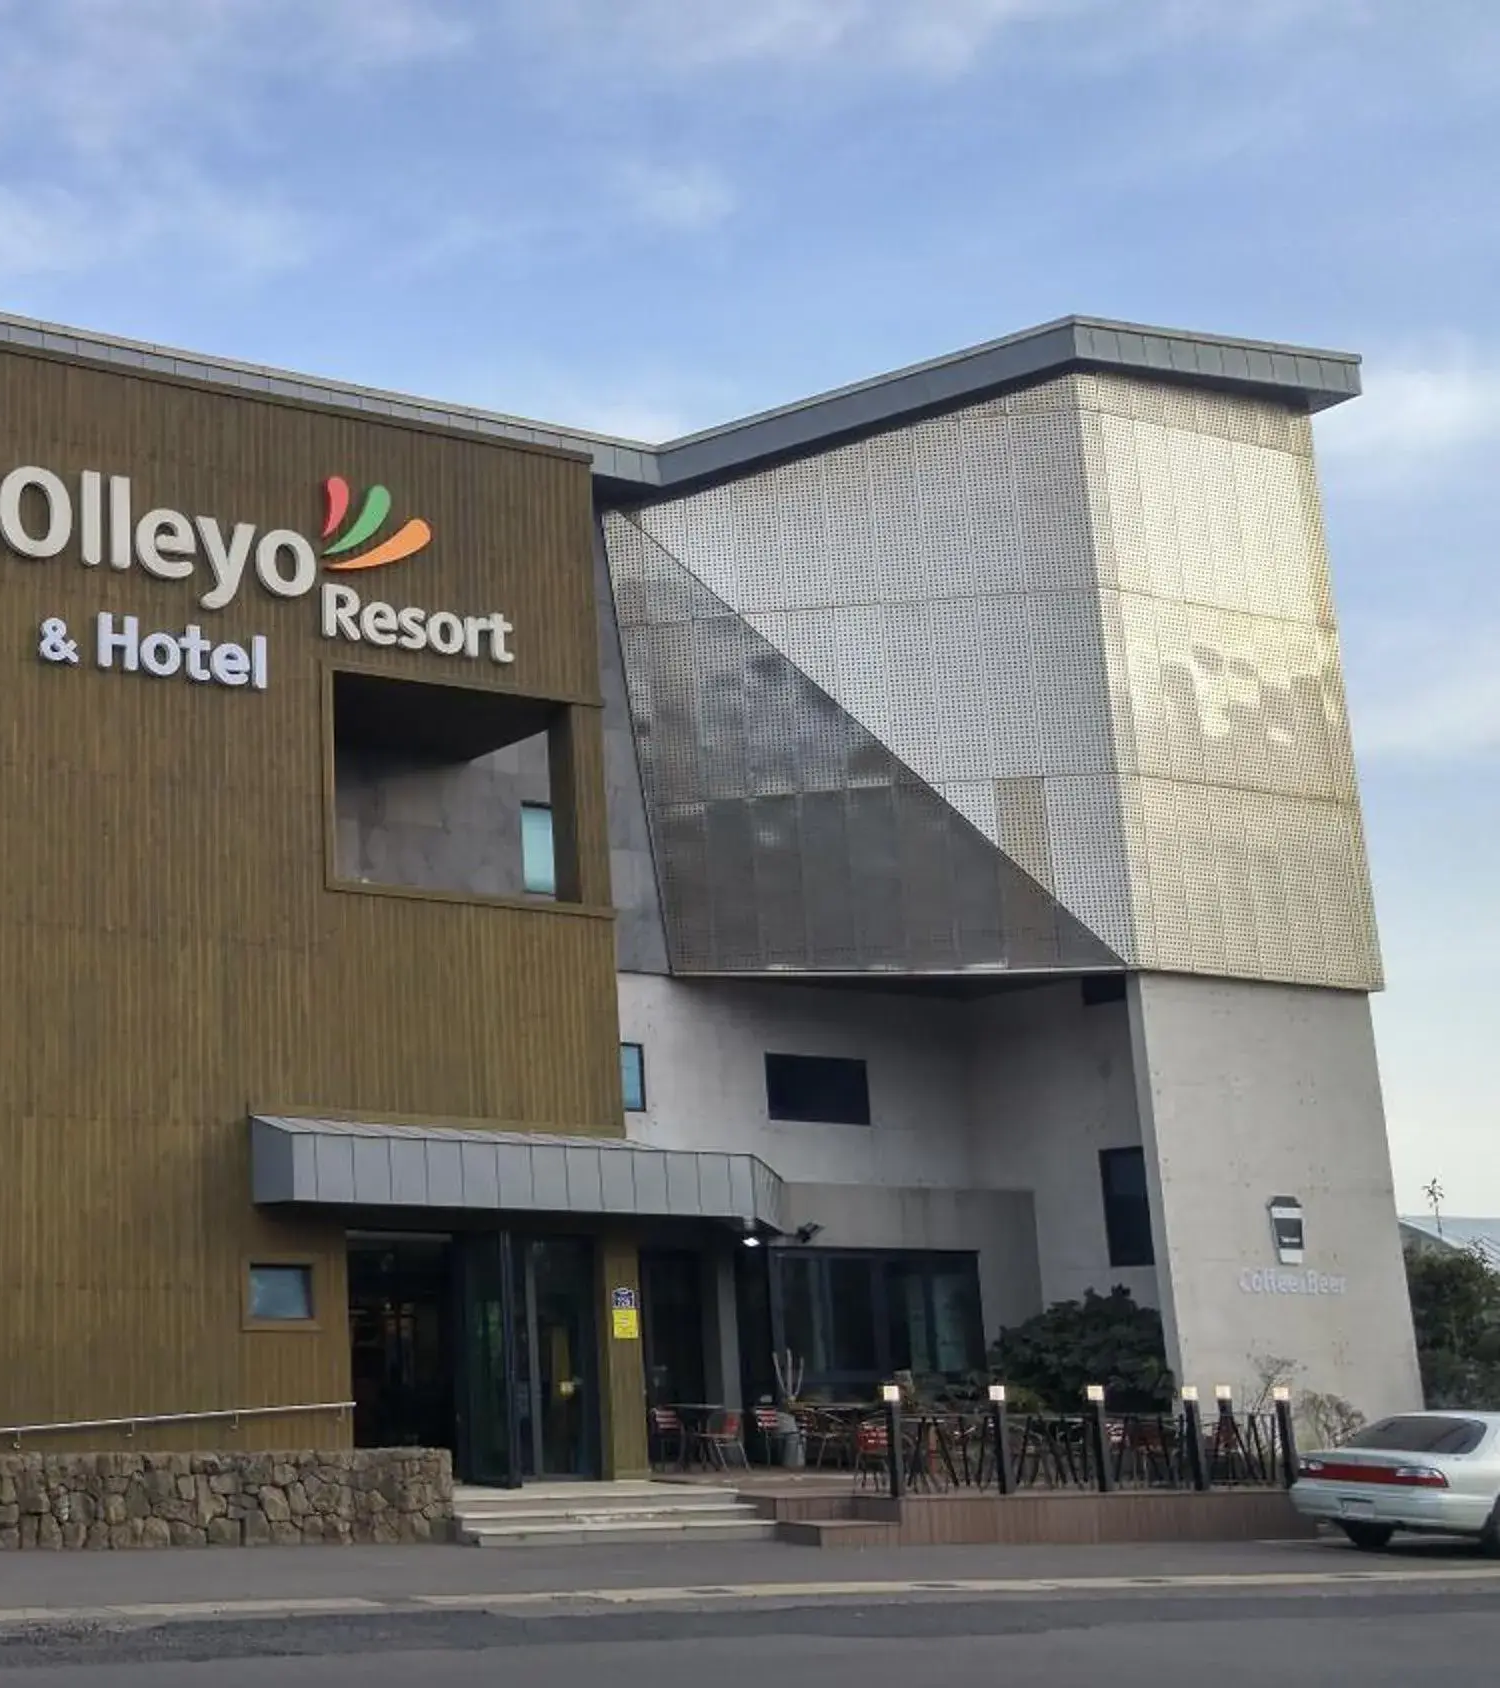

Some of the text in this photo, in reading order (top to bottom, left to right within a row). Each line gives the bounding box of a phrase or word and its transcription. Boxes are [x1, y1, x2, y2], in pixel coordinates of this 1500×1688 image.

[40, 611, 267, 689] & Hotel
[322, 583, 514, 663] Resort
